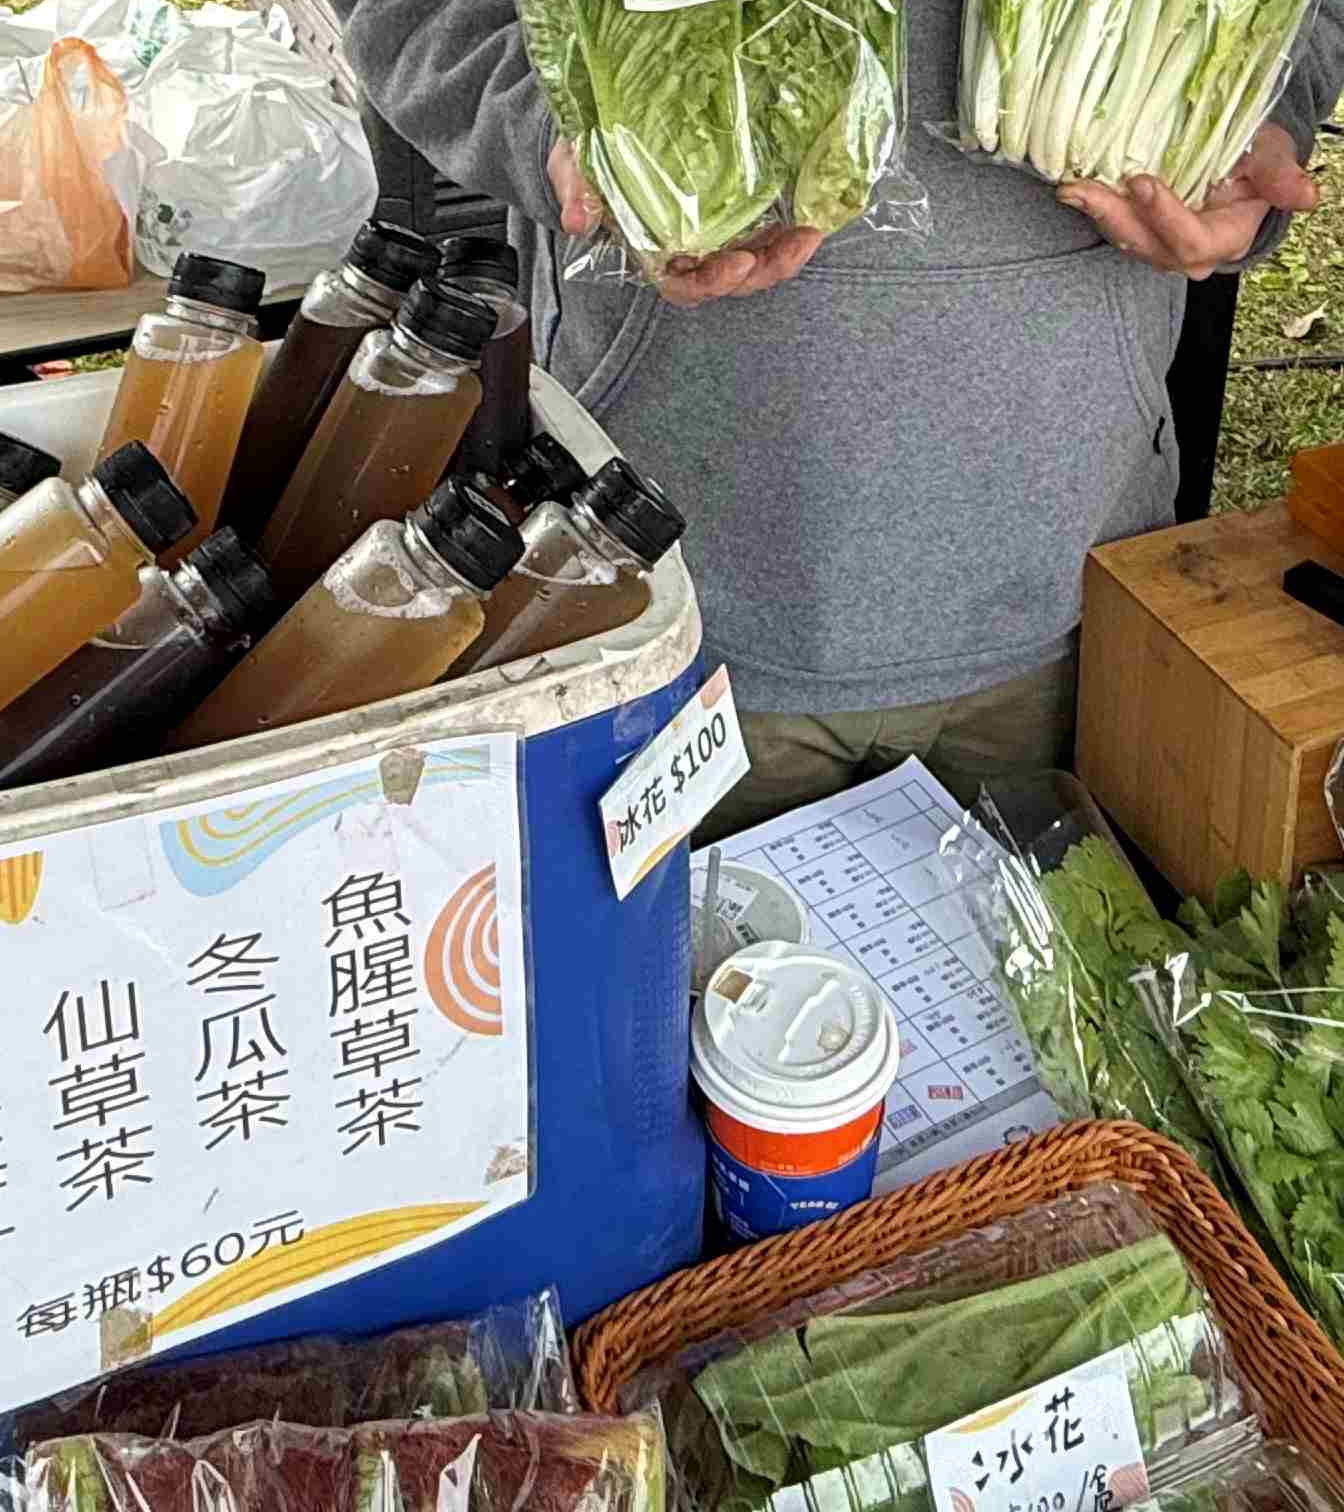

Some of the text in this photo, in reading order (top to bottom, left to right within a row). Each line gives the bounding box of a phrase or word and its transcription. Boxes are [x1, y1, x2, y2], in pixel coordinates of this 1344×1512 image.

[616, 712, 727, 853] 冰花 $100
[42, 978, 156, 1213] 仙草茶
[186, 931, 293, 1151] 冬瓜茶
[320, 871, 426, 1157] 魚腥草茶
[16, 1209, 305, 1338] 每瓶$60元
[971, 1386, 1086, 1493] 冰花
